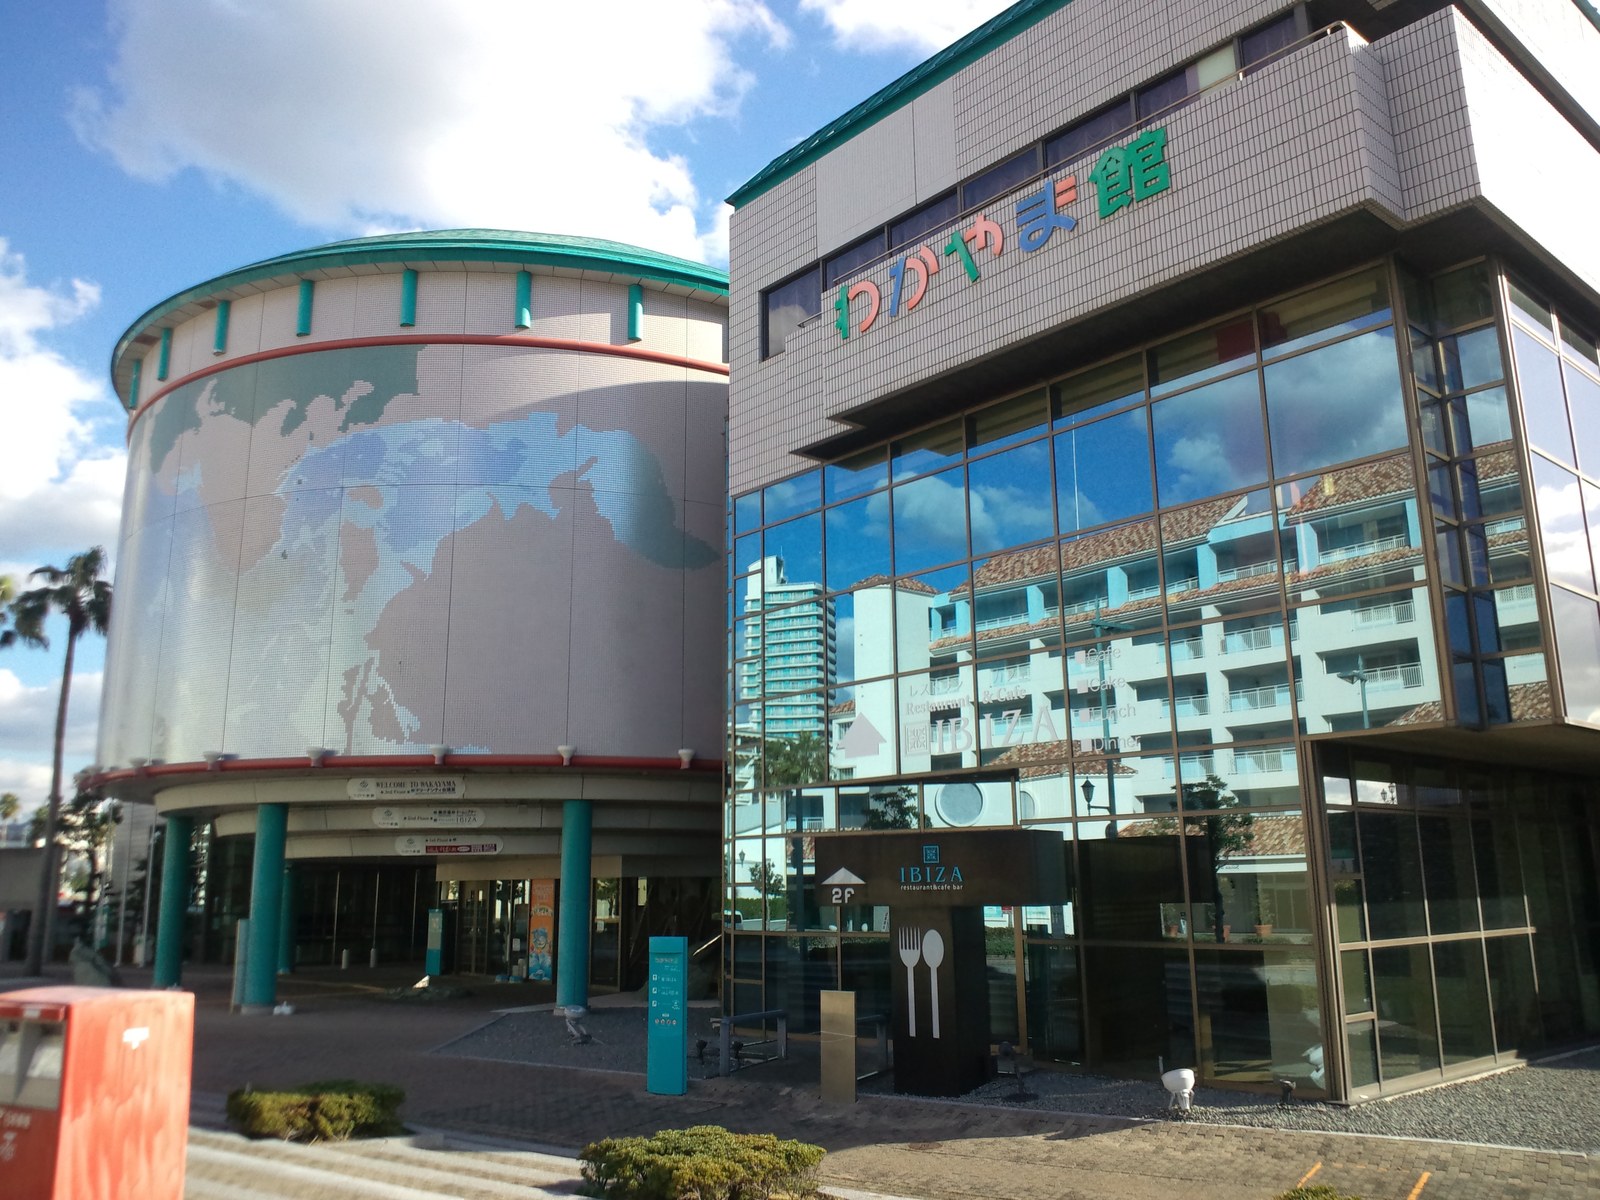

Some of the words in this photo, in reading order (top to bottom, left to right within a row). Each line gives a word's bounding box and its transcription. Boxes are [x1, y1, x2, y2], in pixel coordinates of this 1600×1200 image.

[834, 127, 1171, 340] わかやま館
[1090, 675, 1126, 692] Cake
[906, 693, 971, 716] Restaurant
[982, 688, 993, 705] &
[998, 684, 1027, 702] Cafe
[935, 705, 1059, 754] IBIZA
[1094, 735, 1141, 752] Dinner
[411, 780, 418, 788] TO
[421, 780, 457, 788] WAKAYAMA
[900, 866, 963, 883] IBIZA
[953, 883, 963, 891] bar
